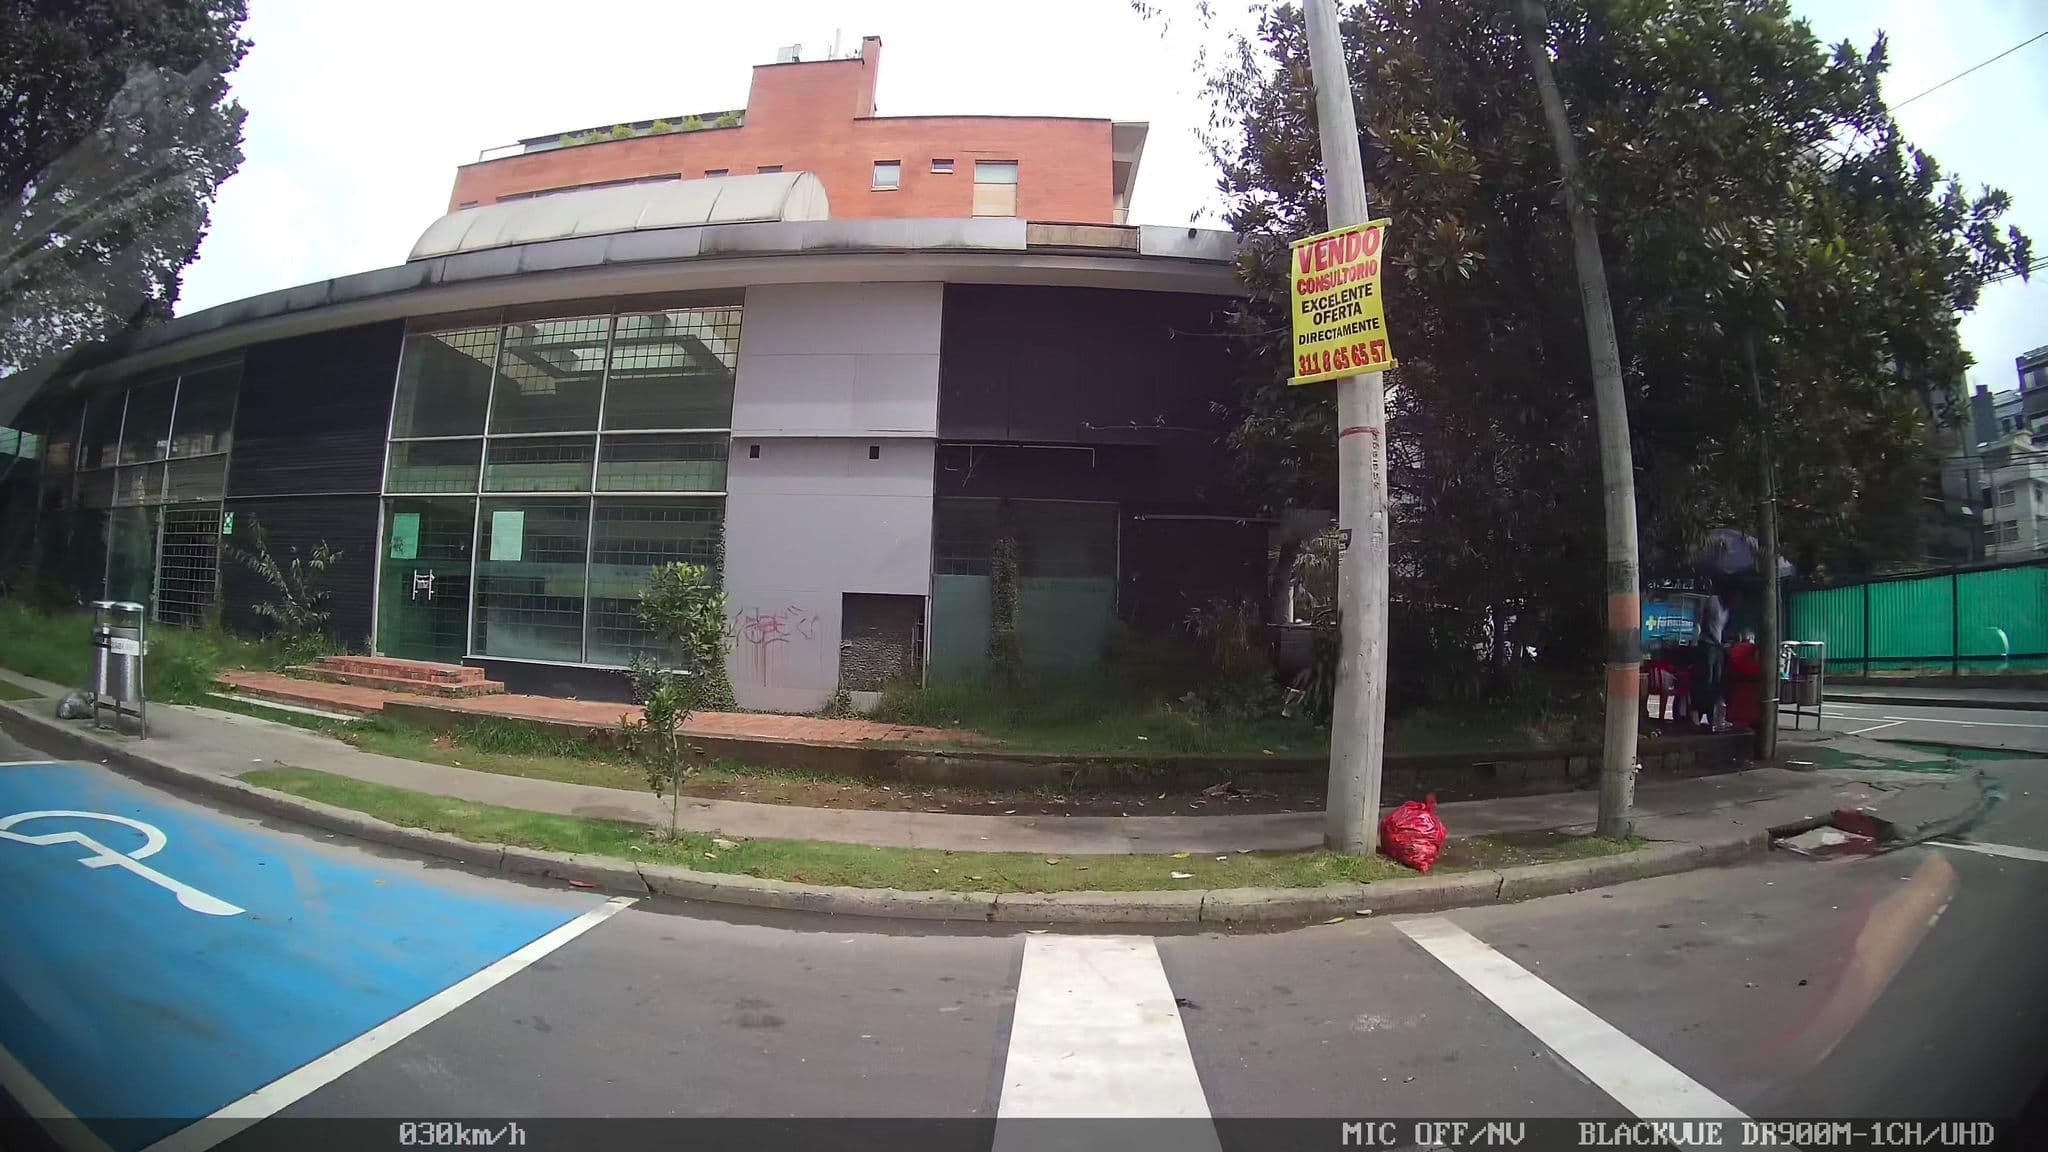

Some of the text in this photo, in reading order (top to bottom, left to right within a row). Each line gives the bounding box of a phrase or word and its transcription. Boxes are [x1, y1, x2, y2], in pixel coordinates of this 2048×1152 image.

[1298, 226, 1380, 273] VENDO
[1297, 259, 1377, 295] CONSULTORIO
[1302, 283, 1373, 314] EXCELENTE
[1313, 303, 1362, 325] OFERTA
[1299, 318, 1380, 345] DIRECTAMENTE
[1299, 339, 1386, 376] 311 8 65 65 57
